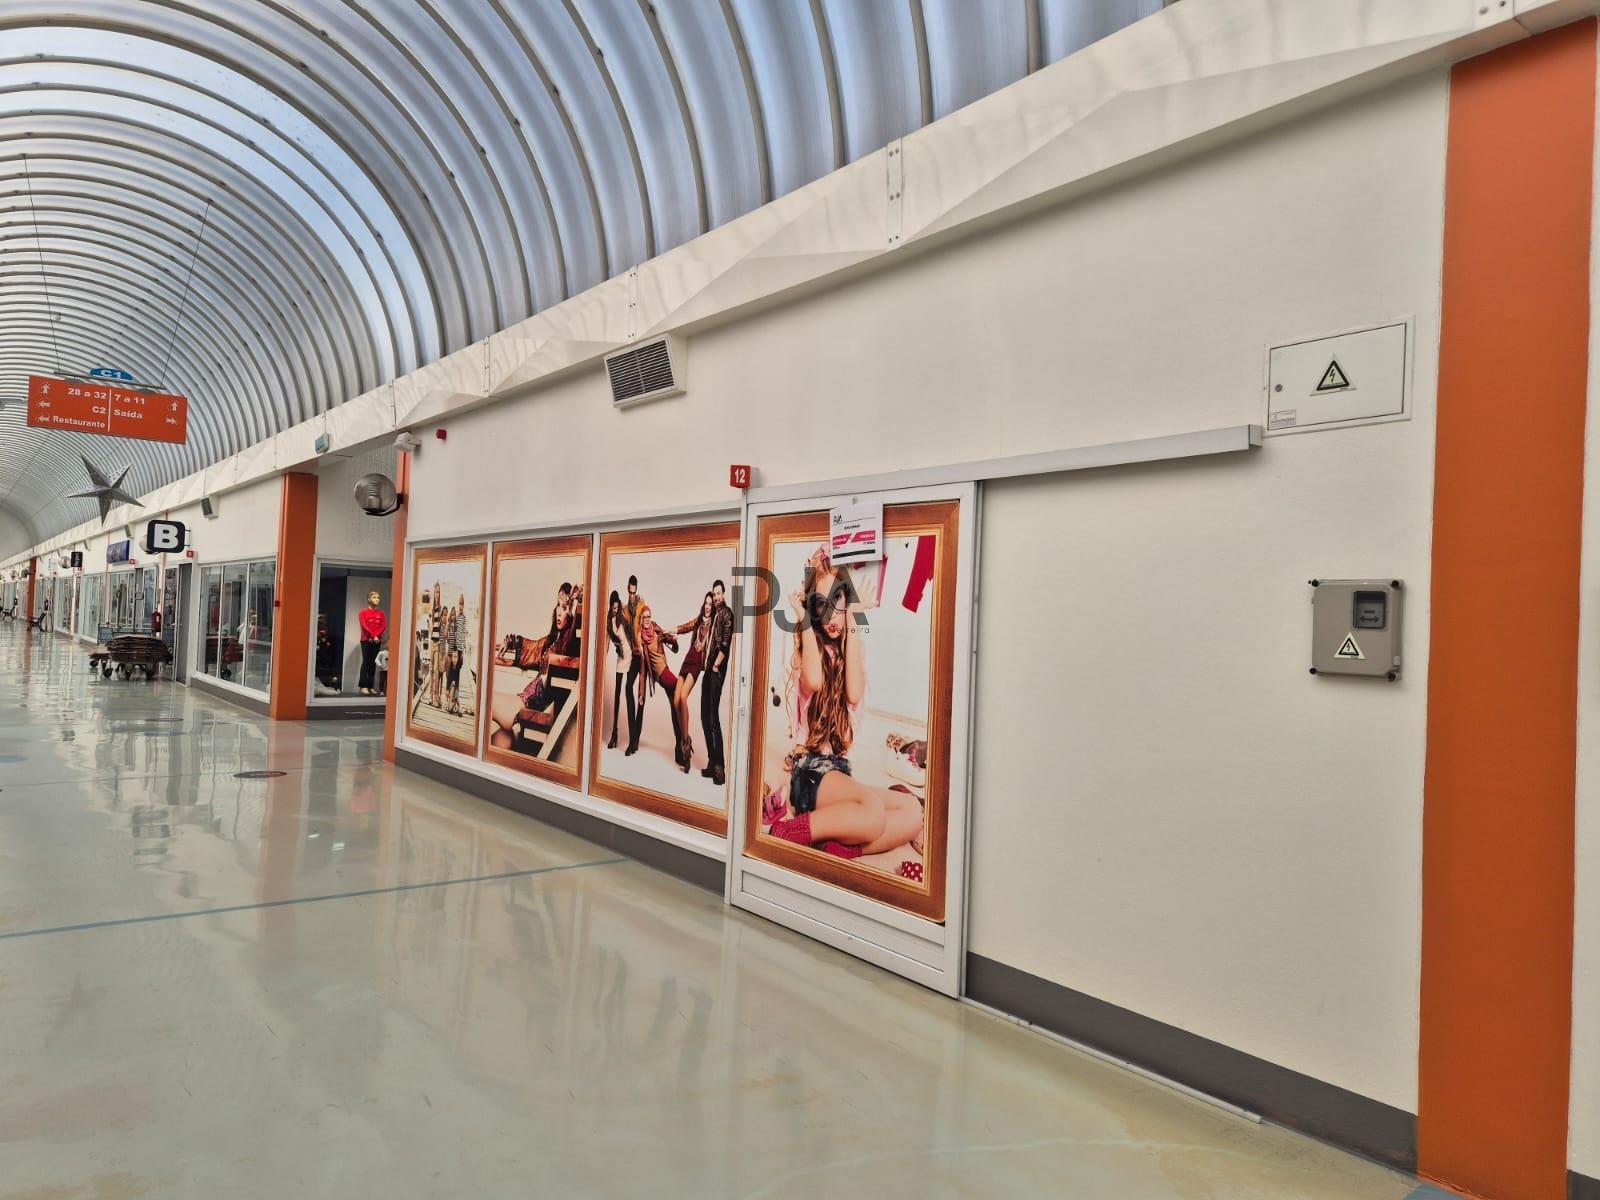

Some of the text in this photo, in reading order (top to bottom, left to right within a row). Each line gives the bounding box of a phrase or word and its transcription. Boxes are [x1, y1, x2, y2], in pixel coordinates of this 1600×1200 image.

[100, 369, 122, 379] C1
[68, 387, 81, 396] 28
[94, 391, 107, 400] 32
[134, 397, 145, 405] 11
[92, 406, 107, 415] C2
[53, 415, 106, 428] Restaurante
[735, 468, 746, 484] 12
[153, 523, 179, 549] B
